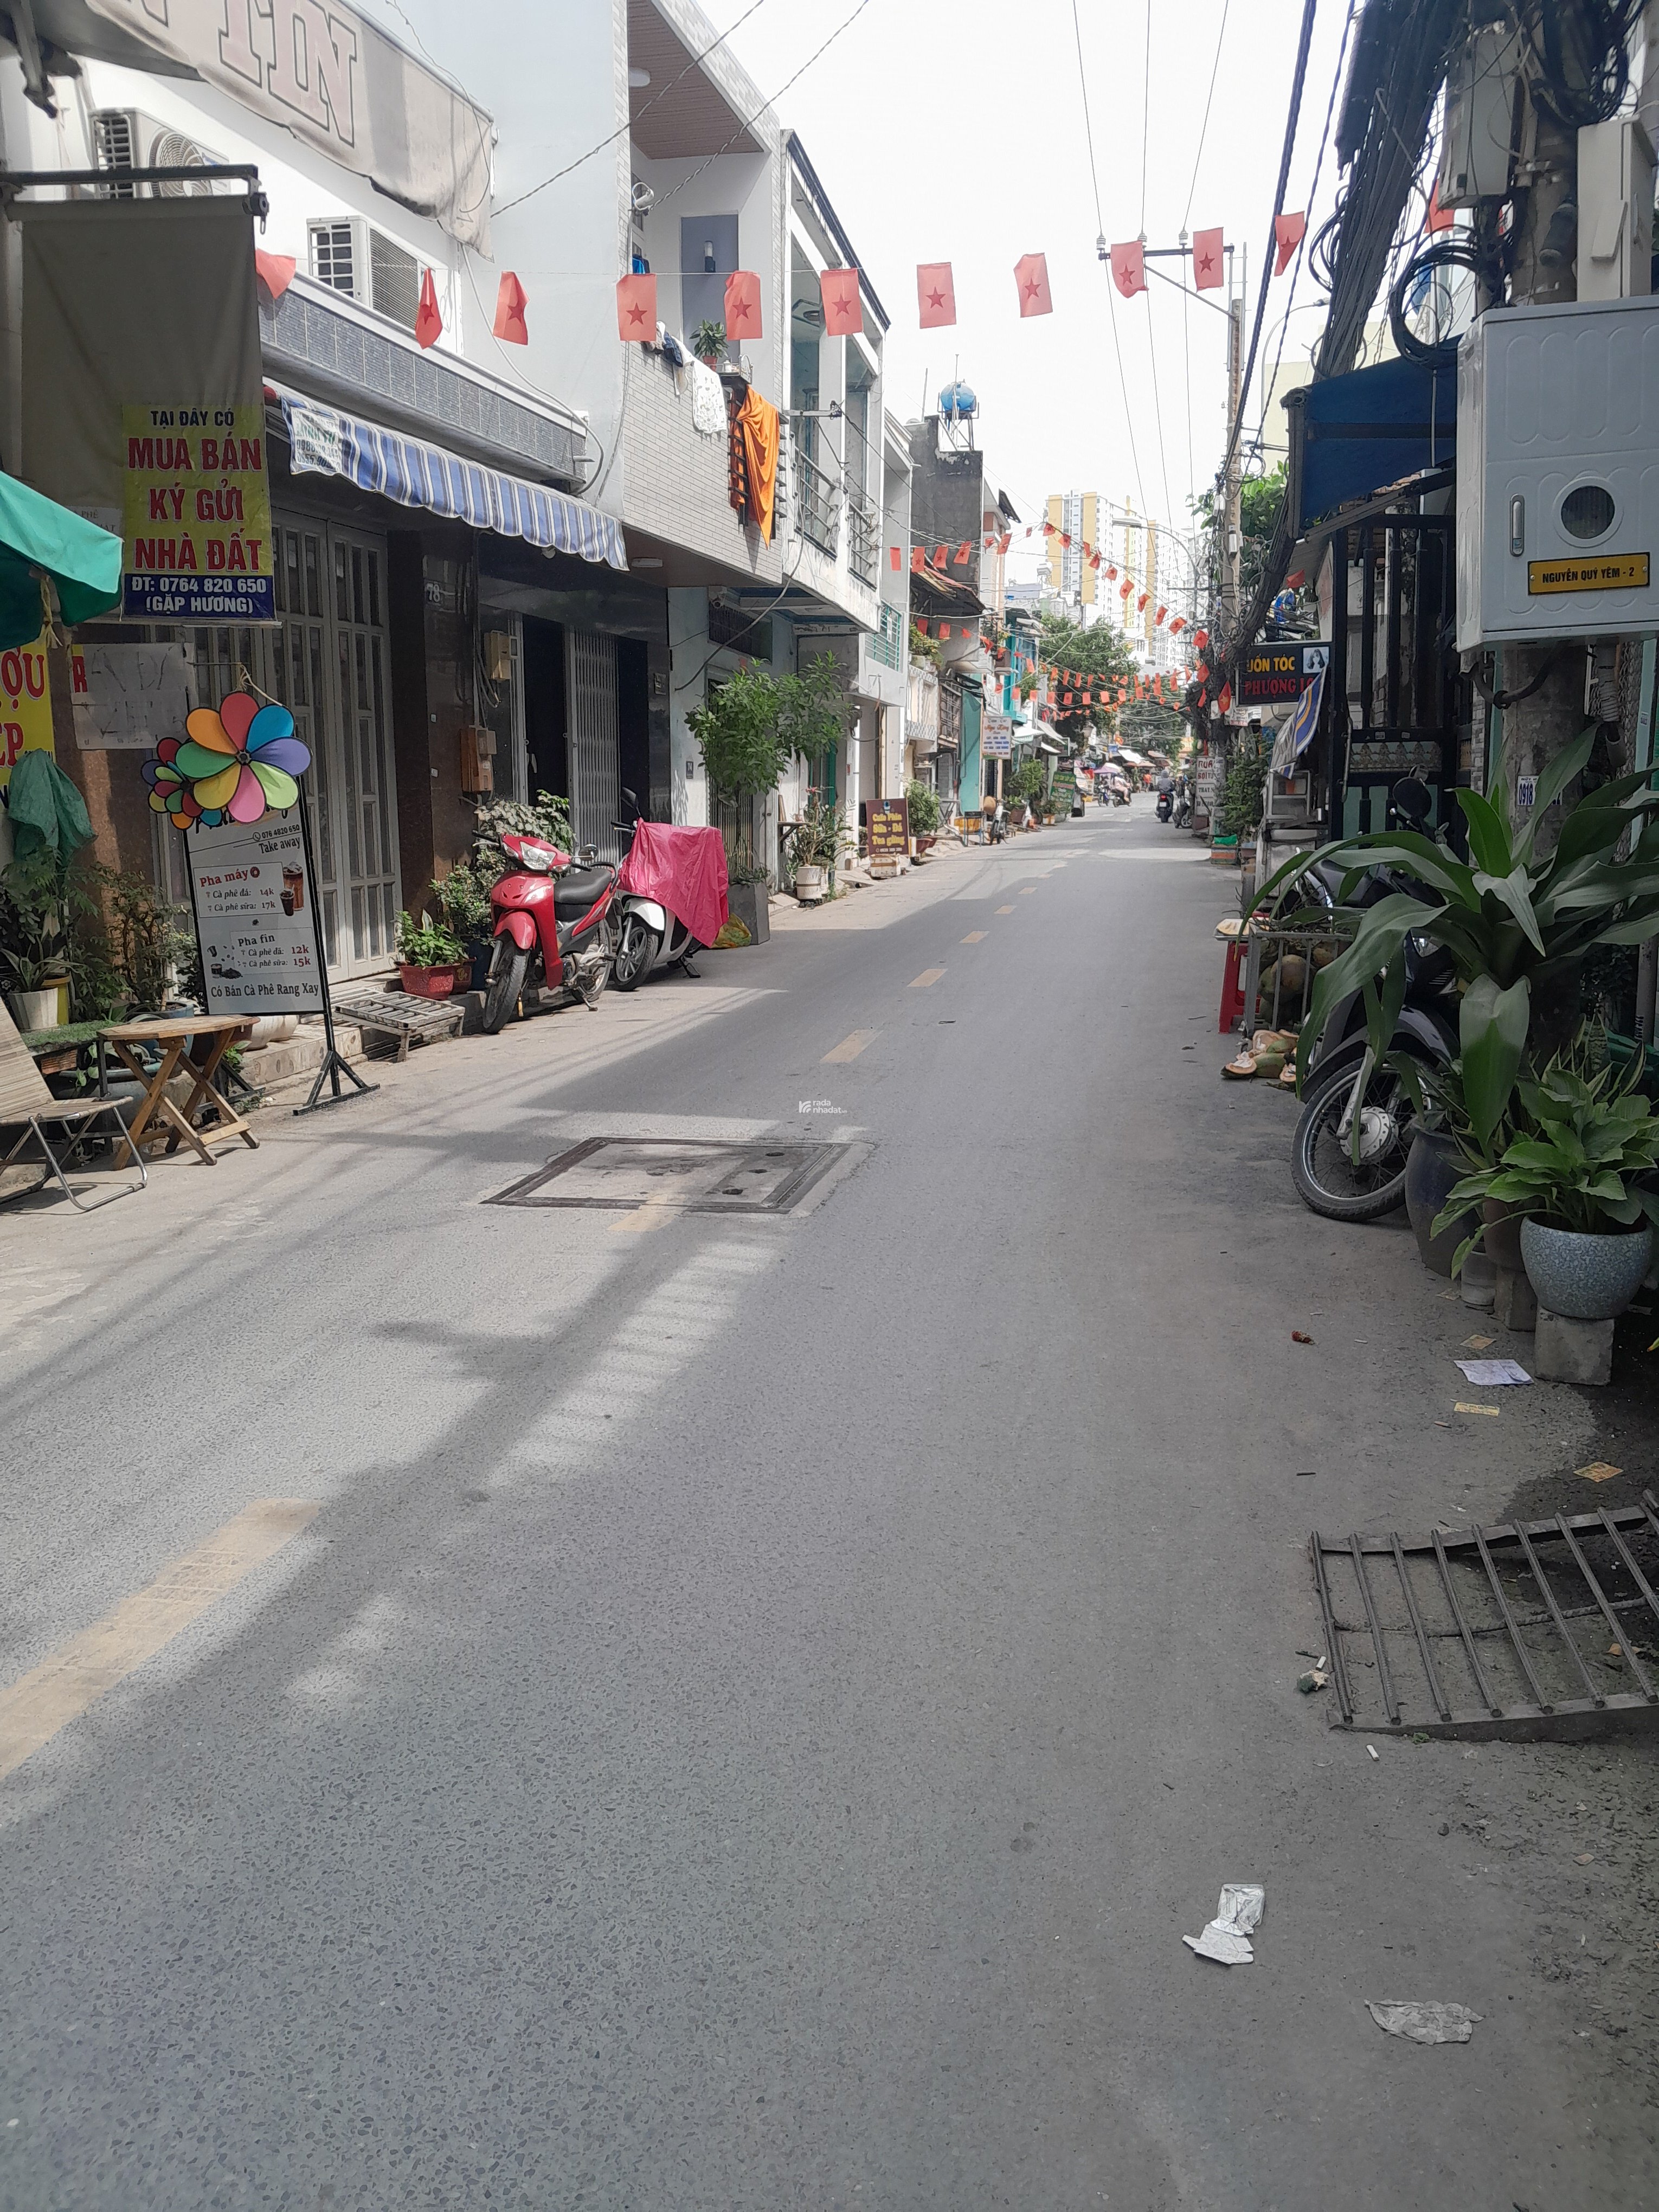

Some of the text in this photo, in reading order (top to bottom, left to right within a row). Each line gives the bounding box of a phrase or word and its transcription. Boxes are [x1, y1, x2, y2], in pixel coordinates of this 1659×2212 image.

[150, 408, 234, 429] TẠI ĐÂY CÓ
[128, 437, 192, 470] MUA
[201, 431, 261, 470] BÁN
[150, 478, 244, 521] KÝ GỬI
[135, 528, 262, 570] NHÀ ĐẤT
[1601, 567, 1620, 578] YÊM
[1629, 567, 1635, 577] 2
[132, 576, 267, 593] ĐT: 0764 820 650
[146, 594, 253, 614] (GẶP HƯƠNG)
[1273, 653, 1295, 672] TÓC
[1244, 677, 1296, 698] PHƯỢNG
[262, 824, 300, 839] 076 4820 650
[259, 837, 300, 854] Take away
[200, 869, 248, 888] Pha máy
[213, 888, 274, 899] Cà phê đá: 14k
[214, 902, 223, 911] Cà
[226, 901, 239, 912] phê
[262, 901, 276, 910] 17k
[237, 934, 275, 947] Pha fin
[248, 948, 258, 956] Cà
[259, 948, 271, 957] phê
[291, 944, 309, 954] 12k
[249, 959, 258, 967] Cà
[259, 959, 271, 968] phê
[293, 956, 311, 967] 15k
[211, 982, 319, 997] Có Bán Cà Phê Rang Xay
